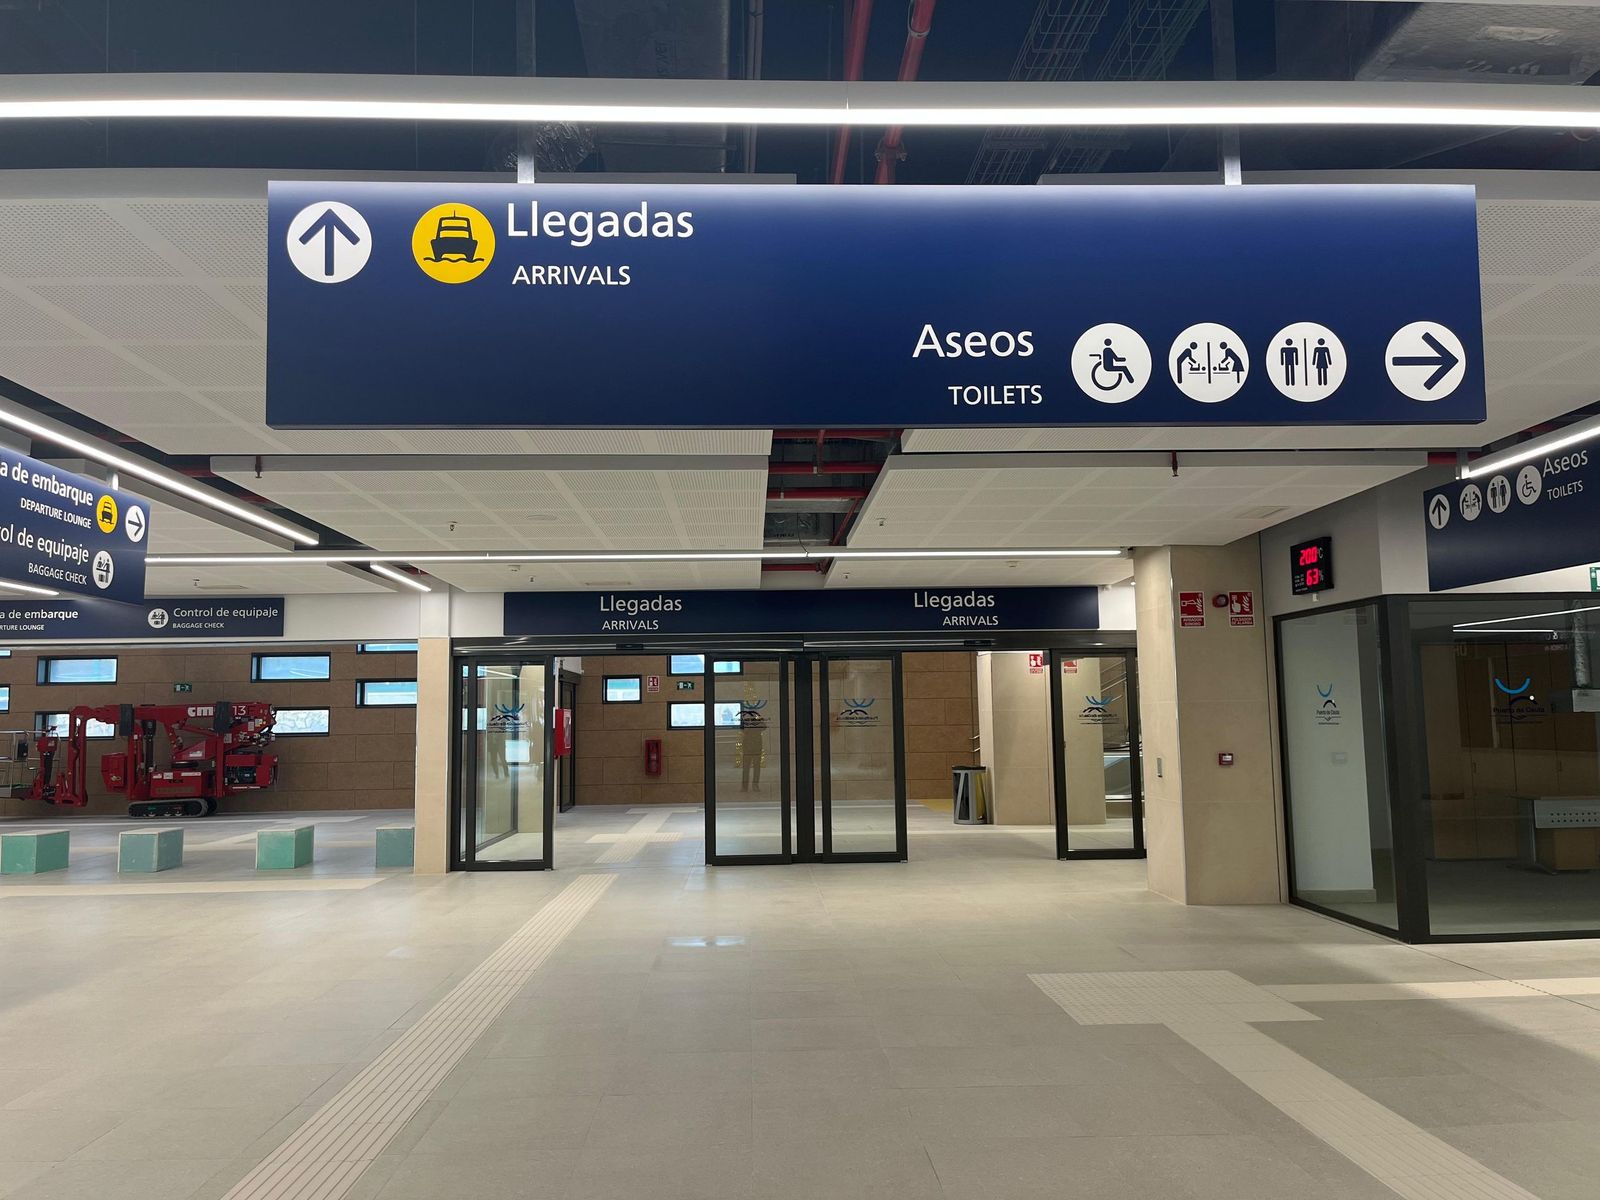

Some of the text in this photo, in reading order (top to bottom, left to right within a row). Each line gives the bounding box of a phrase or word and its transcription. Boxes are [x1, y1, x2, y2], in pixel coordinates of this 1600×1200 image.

[507, 201, 694, 247] Llegadas
[512, 265, 631, 285] ARRIVALS
[912, 324, 1034, 358] Aseos
[948, 385, 1042, 405] TOILETS
[1542, 450, 1589, 478] Aseos
[11, 462, 29, 484] de
[31, 474, 94, 506] embarque
[1547, 480, 1584, 501] TOILETS
[20, 497, 92, 529] DEPARTURE LOUNGE
[17, 527, 34, 548] de
[37, 537, 89, 565] equipaje
[28, 562, 88, 585] BAGGAGE CHECK
[1306, 568, 1319, 586] 63
[600, 594, 682, 616] Llegadas
[914, 591, 995, 612] Llegadas
[8, 609, 22, 619] de
[24, 609, 79, 620] embarque
[173, 607, 278, 618] Control de equipaje
[942, 615, 999, 626] ARRIVALS
[601, 620, 659, 630] ARRIVALS
